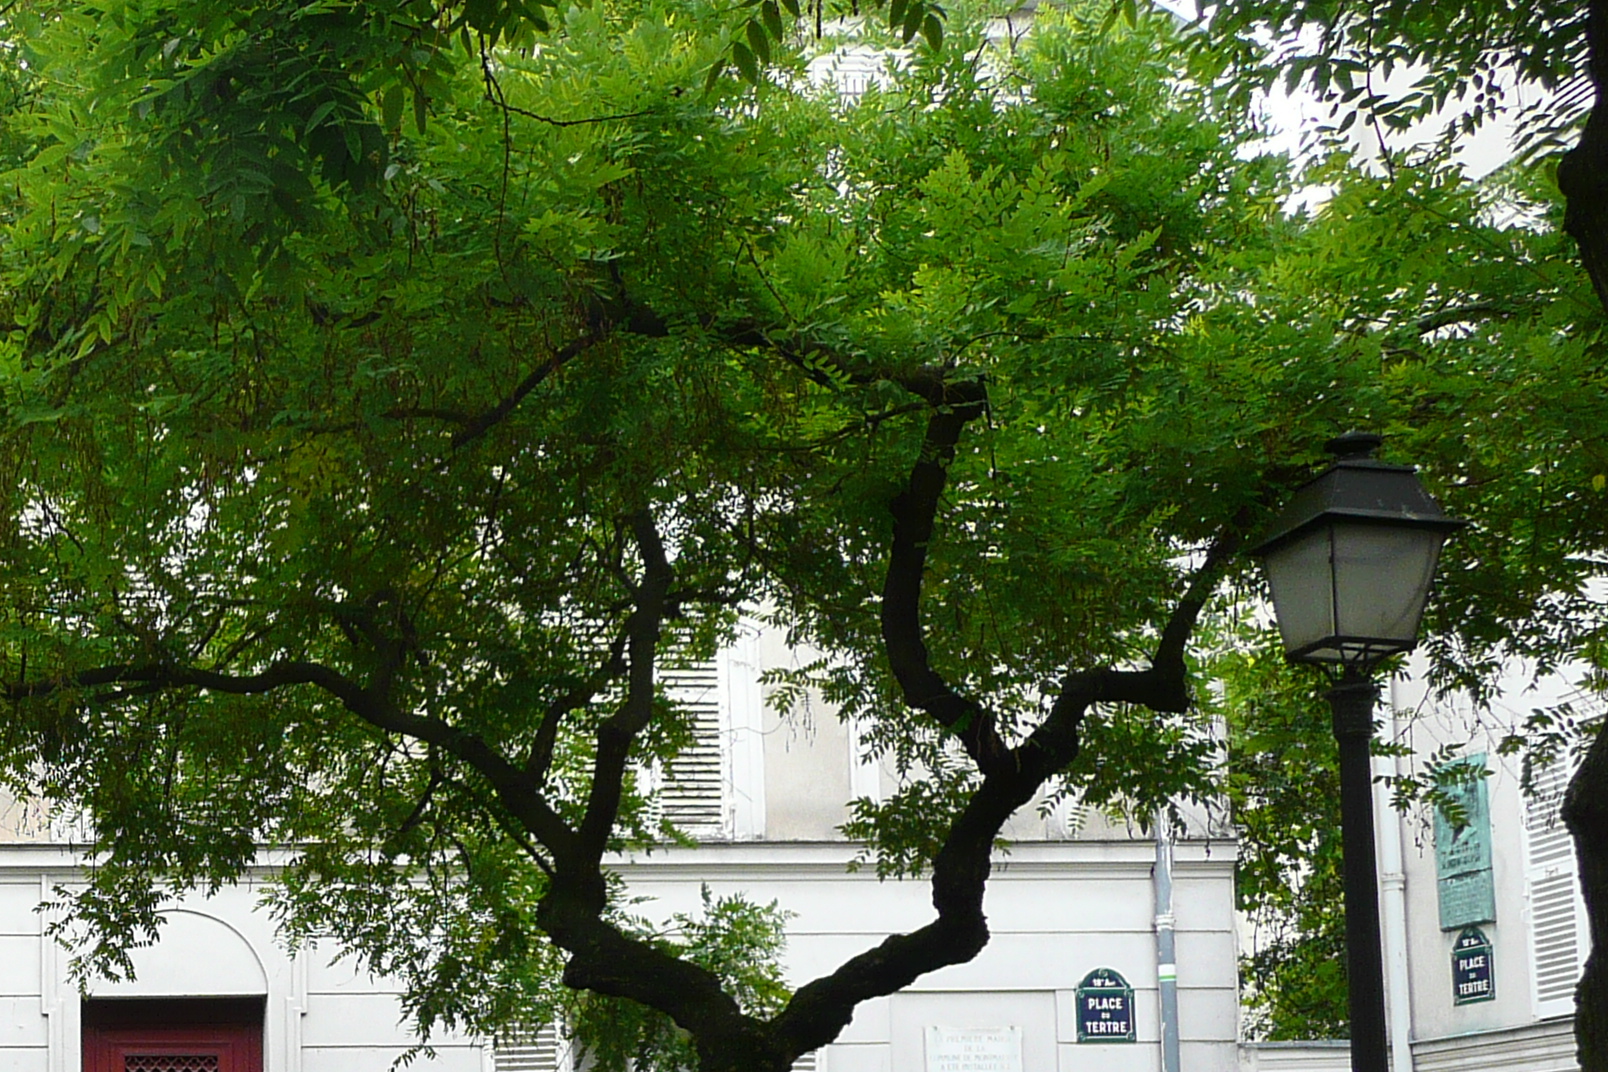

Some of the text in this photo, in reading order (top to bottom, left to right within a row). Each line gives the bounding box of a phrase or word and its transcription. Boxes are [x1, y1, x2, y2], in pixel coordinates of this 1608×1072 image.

[1459, 955, 1485, 971] PLACE
[1459, 979, 1489, 996] TERTRE
[1088, 997, 1123, 1010] PLACE
[1085, 1021, 1127, 1034] TERTRE
